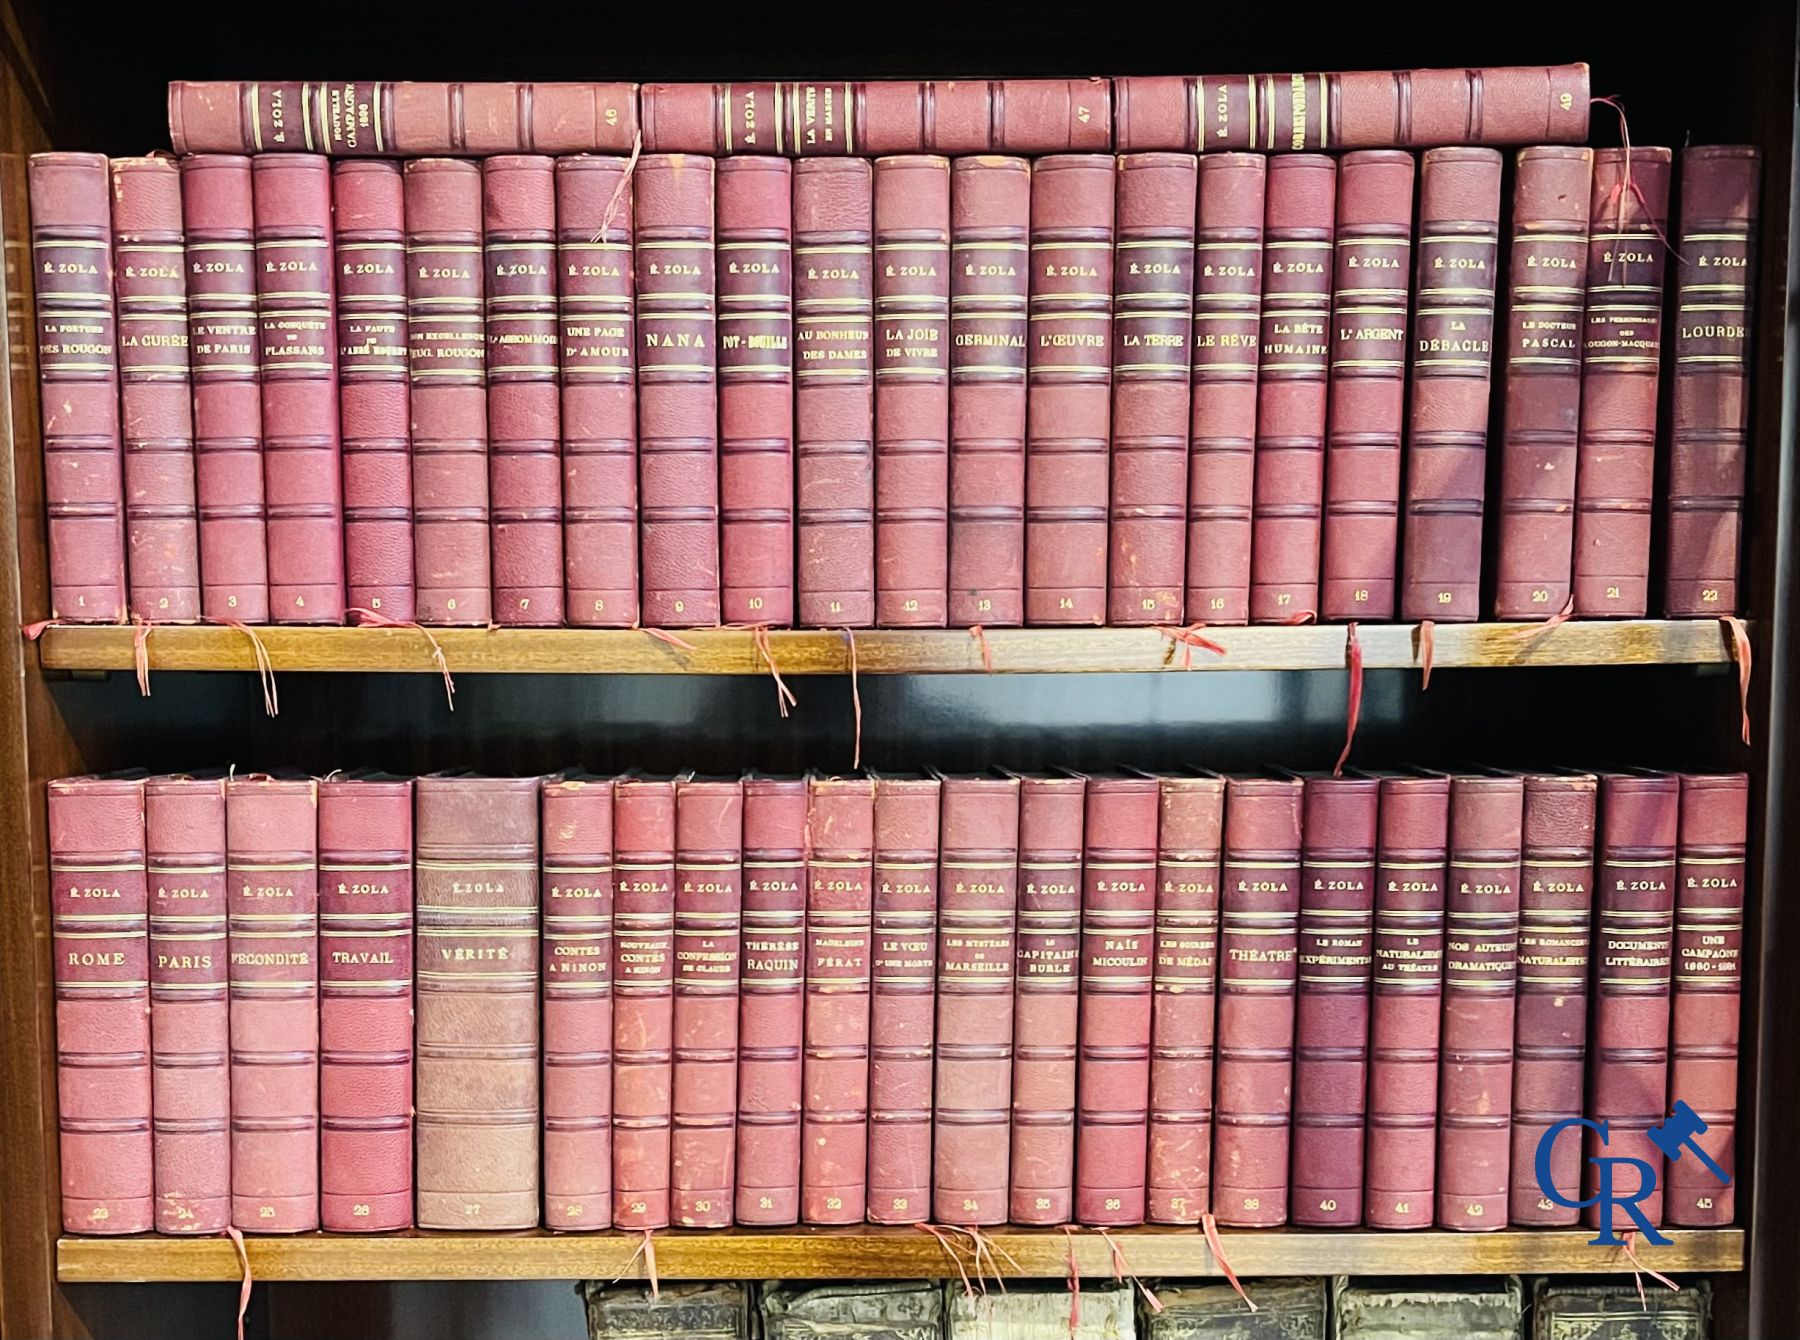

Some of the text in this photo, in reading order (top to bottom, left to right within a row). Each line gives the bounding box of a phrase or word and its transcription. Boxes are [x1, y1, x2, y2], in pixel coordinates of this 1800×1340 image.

[1218, 84, 1228, 123] ZOLA
[1561, 93, 1572, 111] 49
[272, 89, 284, 128] ZOLA
[744, 90, 755, 129] ZOLA
[605, 109, 617, 126] 46
[1077, 105, 1091, 124] 47
[1363, 258, 1399, 267] ZOLA
[1619, 253, 1653, 262] ZOLA
[1714, 257, 1746, 266] ZOLA
[206, 263, 243, 272] ZOLA
[280, 262, 316, 271] ZOLA
[1287, 263, 1323, 273] ZOLA
[1450, 259, 1485, 269] ZOLA
[1543, 258, 1576, 268] ZOLA
[59, 264, 98, 274] ZOLA
[140, 268, 179, 278] ZOLA
[357, 264, 393, 273] ZOLA
[433, 269, 469, 278] ZOLA
[507, 265, 547, 276] ZOLA
[583, 266, 619, 276] ZOLA
[664, 265, 701, 275] ZOLA
[743, 264, 779, 273] ZOLA
[900, 267, 936, 276] ZOLA
[980, 266, 1016, 275] ZOLA
[1061, 266, 1097, 276] ZOLA
[1144, 264, 1180, 274] ZOLA
[1219, 267, 1255, 276] ZOLA
[822, 269, 859, 279] ZOLA
[207, 326, 256, 335] VENTRE
[1275, 324, 1290, 333] LA
[1451, 321, 1465, 330] LA
[567, 327, 624, 337] UNE PAGE
[886, 329, 938, 340] LA JOIE
[122, 336, 138, 346] LA
[646, 334, 705, 347] NANA
[956, 334, 1025, 347] GERMINAL
[1124, 335, 1183, 346] LA TERRE
[1197, 336, 1214, 346] LE
[1523, 338, 1575, 348] PASCAL
[197, 344, 250, 353] DE PARIS
[886, 348, 937, 357] DE VIVRE
[803, 350, 867, 359] DES DAMES
[1355, 590, 1368, 600] 18
[1439, 593, 1451, 603] 19
[1533, 591, 1548, 602] 20
[1607, 588, 1619, 598] 21
[1703, 590, 1717, 601] 22
[79, 596, 85, 606] 1
[160, 598, 168, 608] 2
[229, 596, 236, 607] 3
[296, 596, 304, 606] 4
[448, 599, 456, 609] 6
[520, 599, 529, 609] 7
[749, 598, 762, 609] 10
[1060, 598, 1073, 608] 14
[1211, 599, 1224, 609] 16
[1278, 594, 1291, 605] 17
[595, 600, 603, 611] 8
[676, 601, 683, 612] 9
[831, 602, 841, 612] 11
[902, 600, 917, 611] 12
[979, 600, 991, 611] 13
[1143, 600, 1155, 610] 15
[633, 883, 668, 892] ZOLA
[763, 882, 798, 891] ZOLA
[827, 882, 862, 891] ZOLA
[1111, 882, 1145, 891] ZOLA
[1253, 882, 1287, 892] ZOLA
[1329, 881, 1363, 890] ZOLA
[1403, 883, 1438, 891] ZOLA
[1548, 883, 1584, 892] ZOLA
[1631, 881, 1665, 890] ZOLA
[1703, 878, 1737, 887] ZOLA
[85, 888, 120, 897] ZOLA
[258, 888, 293, 897] ZOLA
[352, 885, 388, 894] ZOLA
[466, 883, 503, 893] ZOLA
[566, 888, 602, 897] ZOLA
[697, 884, 732, 893] ZOLA
[896, 885, 931, 893] ZOLA
[970, 885, 1004, 893] ZOLA
[1041, 885, 1075, 894] ZOLA
[1179, 884, 1213, 893] ZOLA
[1476, 885, 1511, 894] ZOLA
[172, 889, 209, 898] ZOLA
[1703, 936, 1724, 944] UNE
[554, 947, 600, 955] CONTES
[883, 942, 898, 951] LE
[69, 953, 124, 965] ROME
[159, 955, 211, 968] PARIS
[332, 952, 393, 963] TRAVAIL
[1093, 957, 1148, 966] MICOULIN
[562, 963, 606, 972] NINON
[748, 959, 798, 971] RAQUIN
[946, 962, 1009, 971] MARSEILLE
[1030, 964, 1070, 972] BURLE
[696, 1201, 710, 1211] 30
[760, 1197, 772, 1208] 31
[827, 1198, 841, 1209] 32
[964, 1200, 978, 1210] 34
[1106, 1199, 1120, 1210] 36
[1320, 1200, 1336, 1210] 40
[1697, 1198, 1712, 1208] 45
[259, 1207, 275, 1217] 25
[354, 1205, 369, 1215] 26
[632, 1203, 646, 1213] 29
[1395, 1203, 1409, 1213] 41
